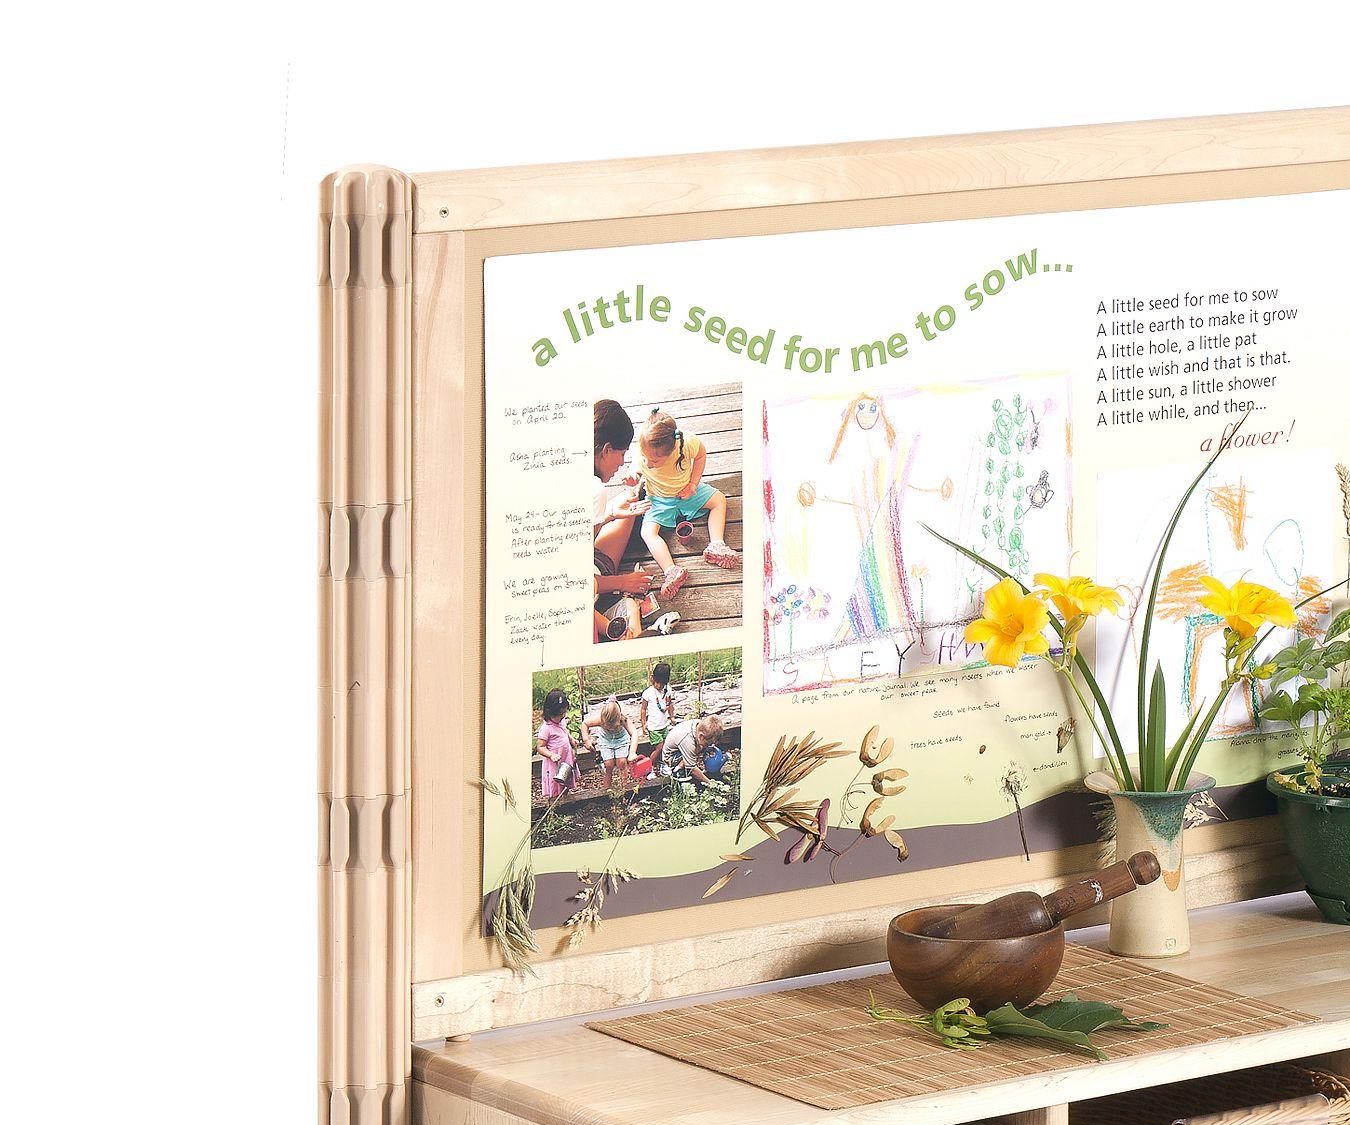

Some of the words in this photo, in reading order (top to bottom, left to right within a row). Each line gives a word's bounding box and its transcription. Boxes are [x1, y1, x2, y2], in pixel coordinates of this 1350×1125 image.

[531, 335, 558, 367] a
[562, 284, 671, 343] little
[683, 303, 776, 365] seed
[783, 335, 841, 374] for
[849, 332, 908, 372] me
[914, 302, 958, 341] to
[964, 247, 1074, 312] sow...
[1096, 301, 1107, 314] A
[1112, 297, 1144, 314] little
[1148, 294, 1179, 310] seed
[1184, 292, 1204, 306] for
[1208, 292, 1229, 305] me
[1233, 290, 1248, 302] to
[1252, 289, 1278, 301] sow
[1096, 323, 1107, 337] A
[1112, 318, 1144, 335] little
[1149, 314, 1184, 332] earth
[1189, 315, 1204, 329] to
[1208, 311, 1245, 327] make
[1250, 309, 1259, 322] it
[1263, 307, 1298, 326] grow
[1096, 346, 1107, 359] A
[1112, 340, 1144, 357] little
[1149, 337, 1182, 354] hole,
[1187, 340, 1195, 351] a
[1199, 333, 1230, 350] little
[1235, 332, 1257, 350] pat
[1096, 368, 1107, 382] A
[1112, 362, 1144, 380] little
[1148, 358, 1179, 377] wish
[1184, 354, 1209, 373] and
[1214, 354, 1242, 370] that
[1246, 353, 1255, 366] is
[1260, 351, 1291, 366] that.
[1096, 390, 1107, 404] A
[1112, 384, 1144, 402] little
[1148, 386, 1175, 401] sun,
[1180, 385, 1188, 396] a
[1192, 378, 1223, 395] little
[1228, 374, 1276, 390] shower
[505, 407, 517, 417] We
[522, 402, 550, 416] planted
[555, 402, 567, 410] our
[1096, 412, 1107, 427] A
[1112, 407, 1144, 424] little
[1148, 403, 1189, 421] while,
[1194, 401, 1220, 417] and
[1224, 399, 1266, 414] then...
[527, 414, 549, 424] April
[1200, 438, 1212, 452] a
[1217, 419, 1296, 452] flower!
[534, 447, 565, 460] planting
[505, 513, 522, 524] May
[543, 510, 557, 518] Our
[562, 507, 585, 519] garden
[512, 526, 519, 534] is
[523, 523, 545, 533] ready
[511, 538, 531, 548] After
[535, 534, 563, 546] planting
[513, 550, 531, 559] needs
[504, 579, 516, 590] We
[522, 578, 535, 586] are
[541, 572, 569, 586] growing
[510, 636, 530, 645] every
